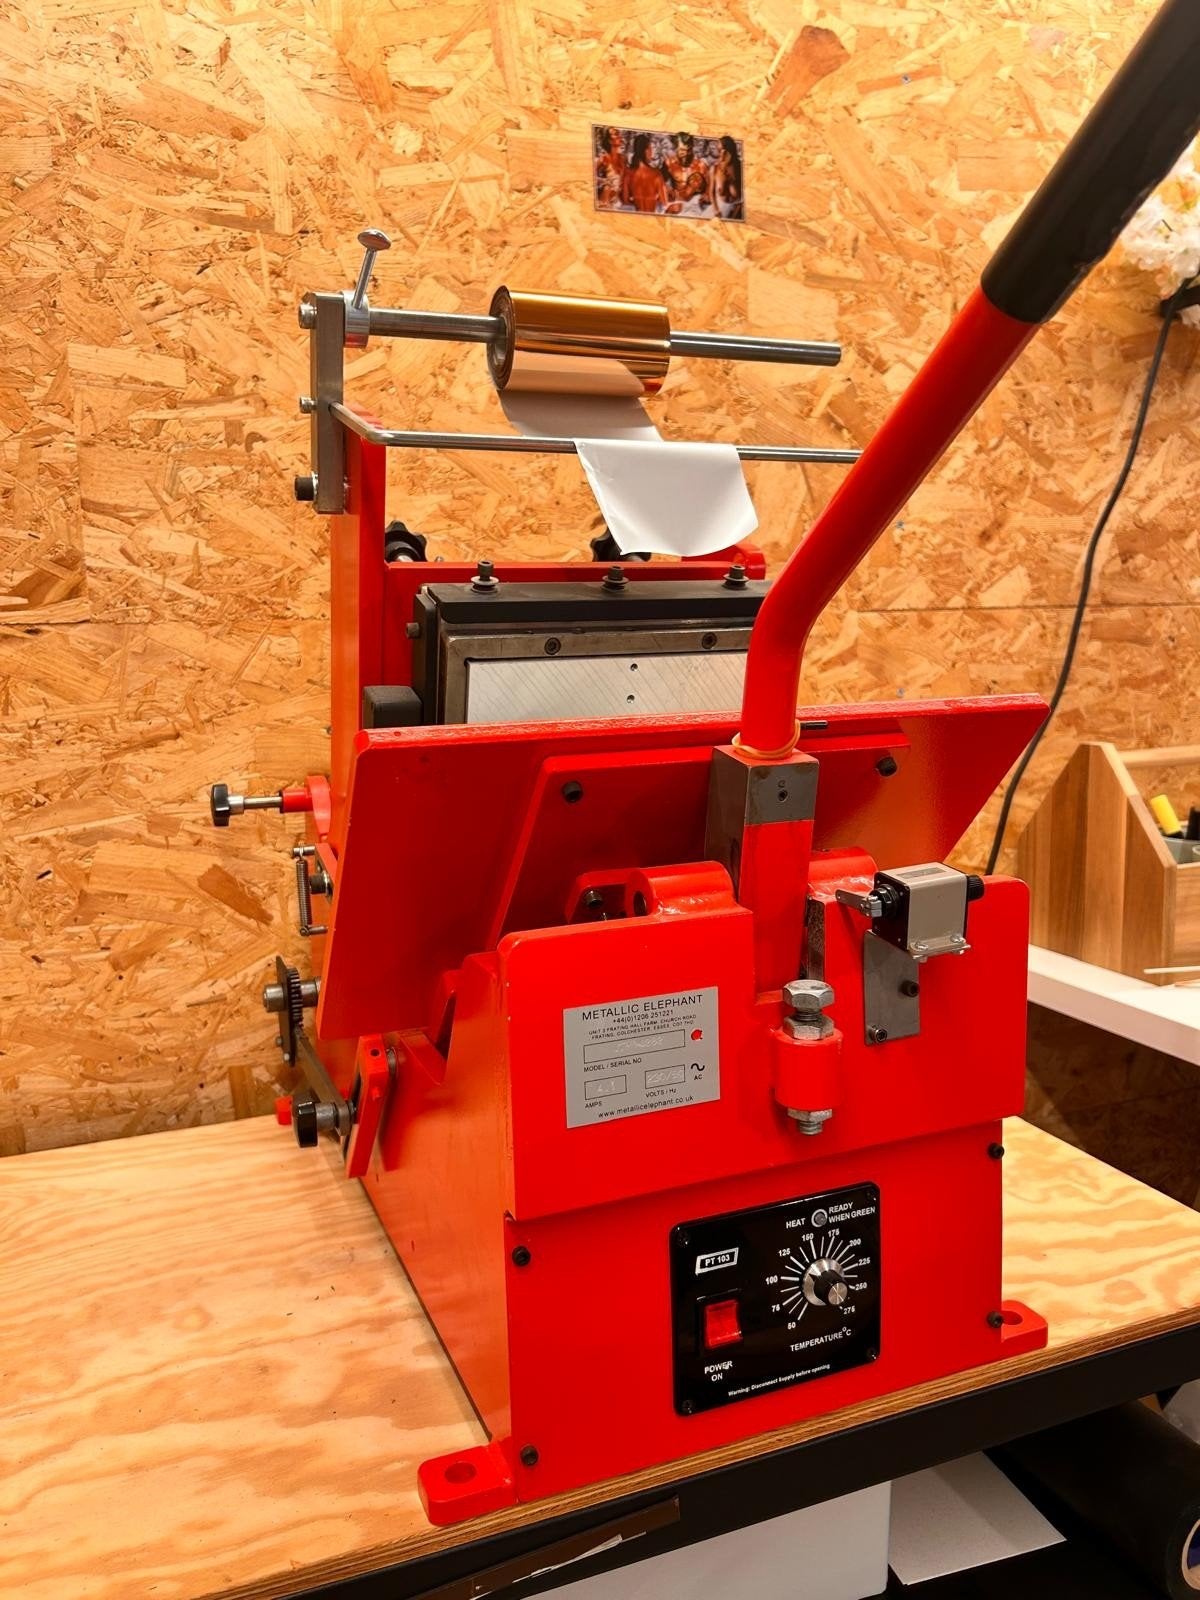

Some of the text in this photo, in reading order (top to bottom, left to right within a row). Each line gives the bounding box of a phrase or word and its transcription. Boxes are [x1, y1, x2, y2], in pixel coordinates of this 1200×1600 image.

[582, 995, 703, 1021] METALLIC ELEPHANT
[613, 1010, 673, 1024] +44(0)1206 251221
[607, 1024, 629, 1032] FRATING
[610, 1060, 631, 1068] SERIAL
[646, 1090, 664, 1098] VOLTS
[585, 1100, 602, 1109] AMPS
[829, 1202, 854, 1214] READY
[829, 1206, 876, 1223] WHEN GREEN
[786, 1218, 805, 1229] HEAT
[802, 1233, 814, 1241] 150
[828, 1229, 840, 1238] 175
[849, 1238, 861, 1247] 200
[778, 1248, 791, 1257] 125
[705, 1254, 730, 1266] PT 103
[858, 1257, 871, 1266] 225
[765, 1275, 778, 1285] 100
[855, 1282, 867, 1290] 250
[772, 1304, 780, 1312] 75
[843, 1306, 855, 1315] 275
[704, 1360, 733, 1374] POWER
[711, 1373, 723, 1382] ON
[728, 1364, 830, 1396] Warning: Disconnect Supply before opening
